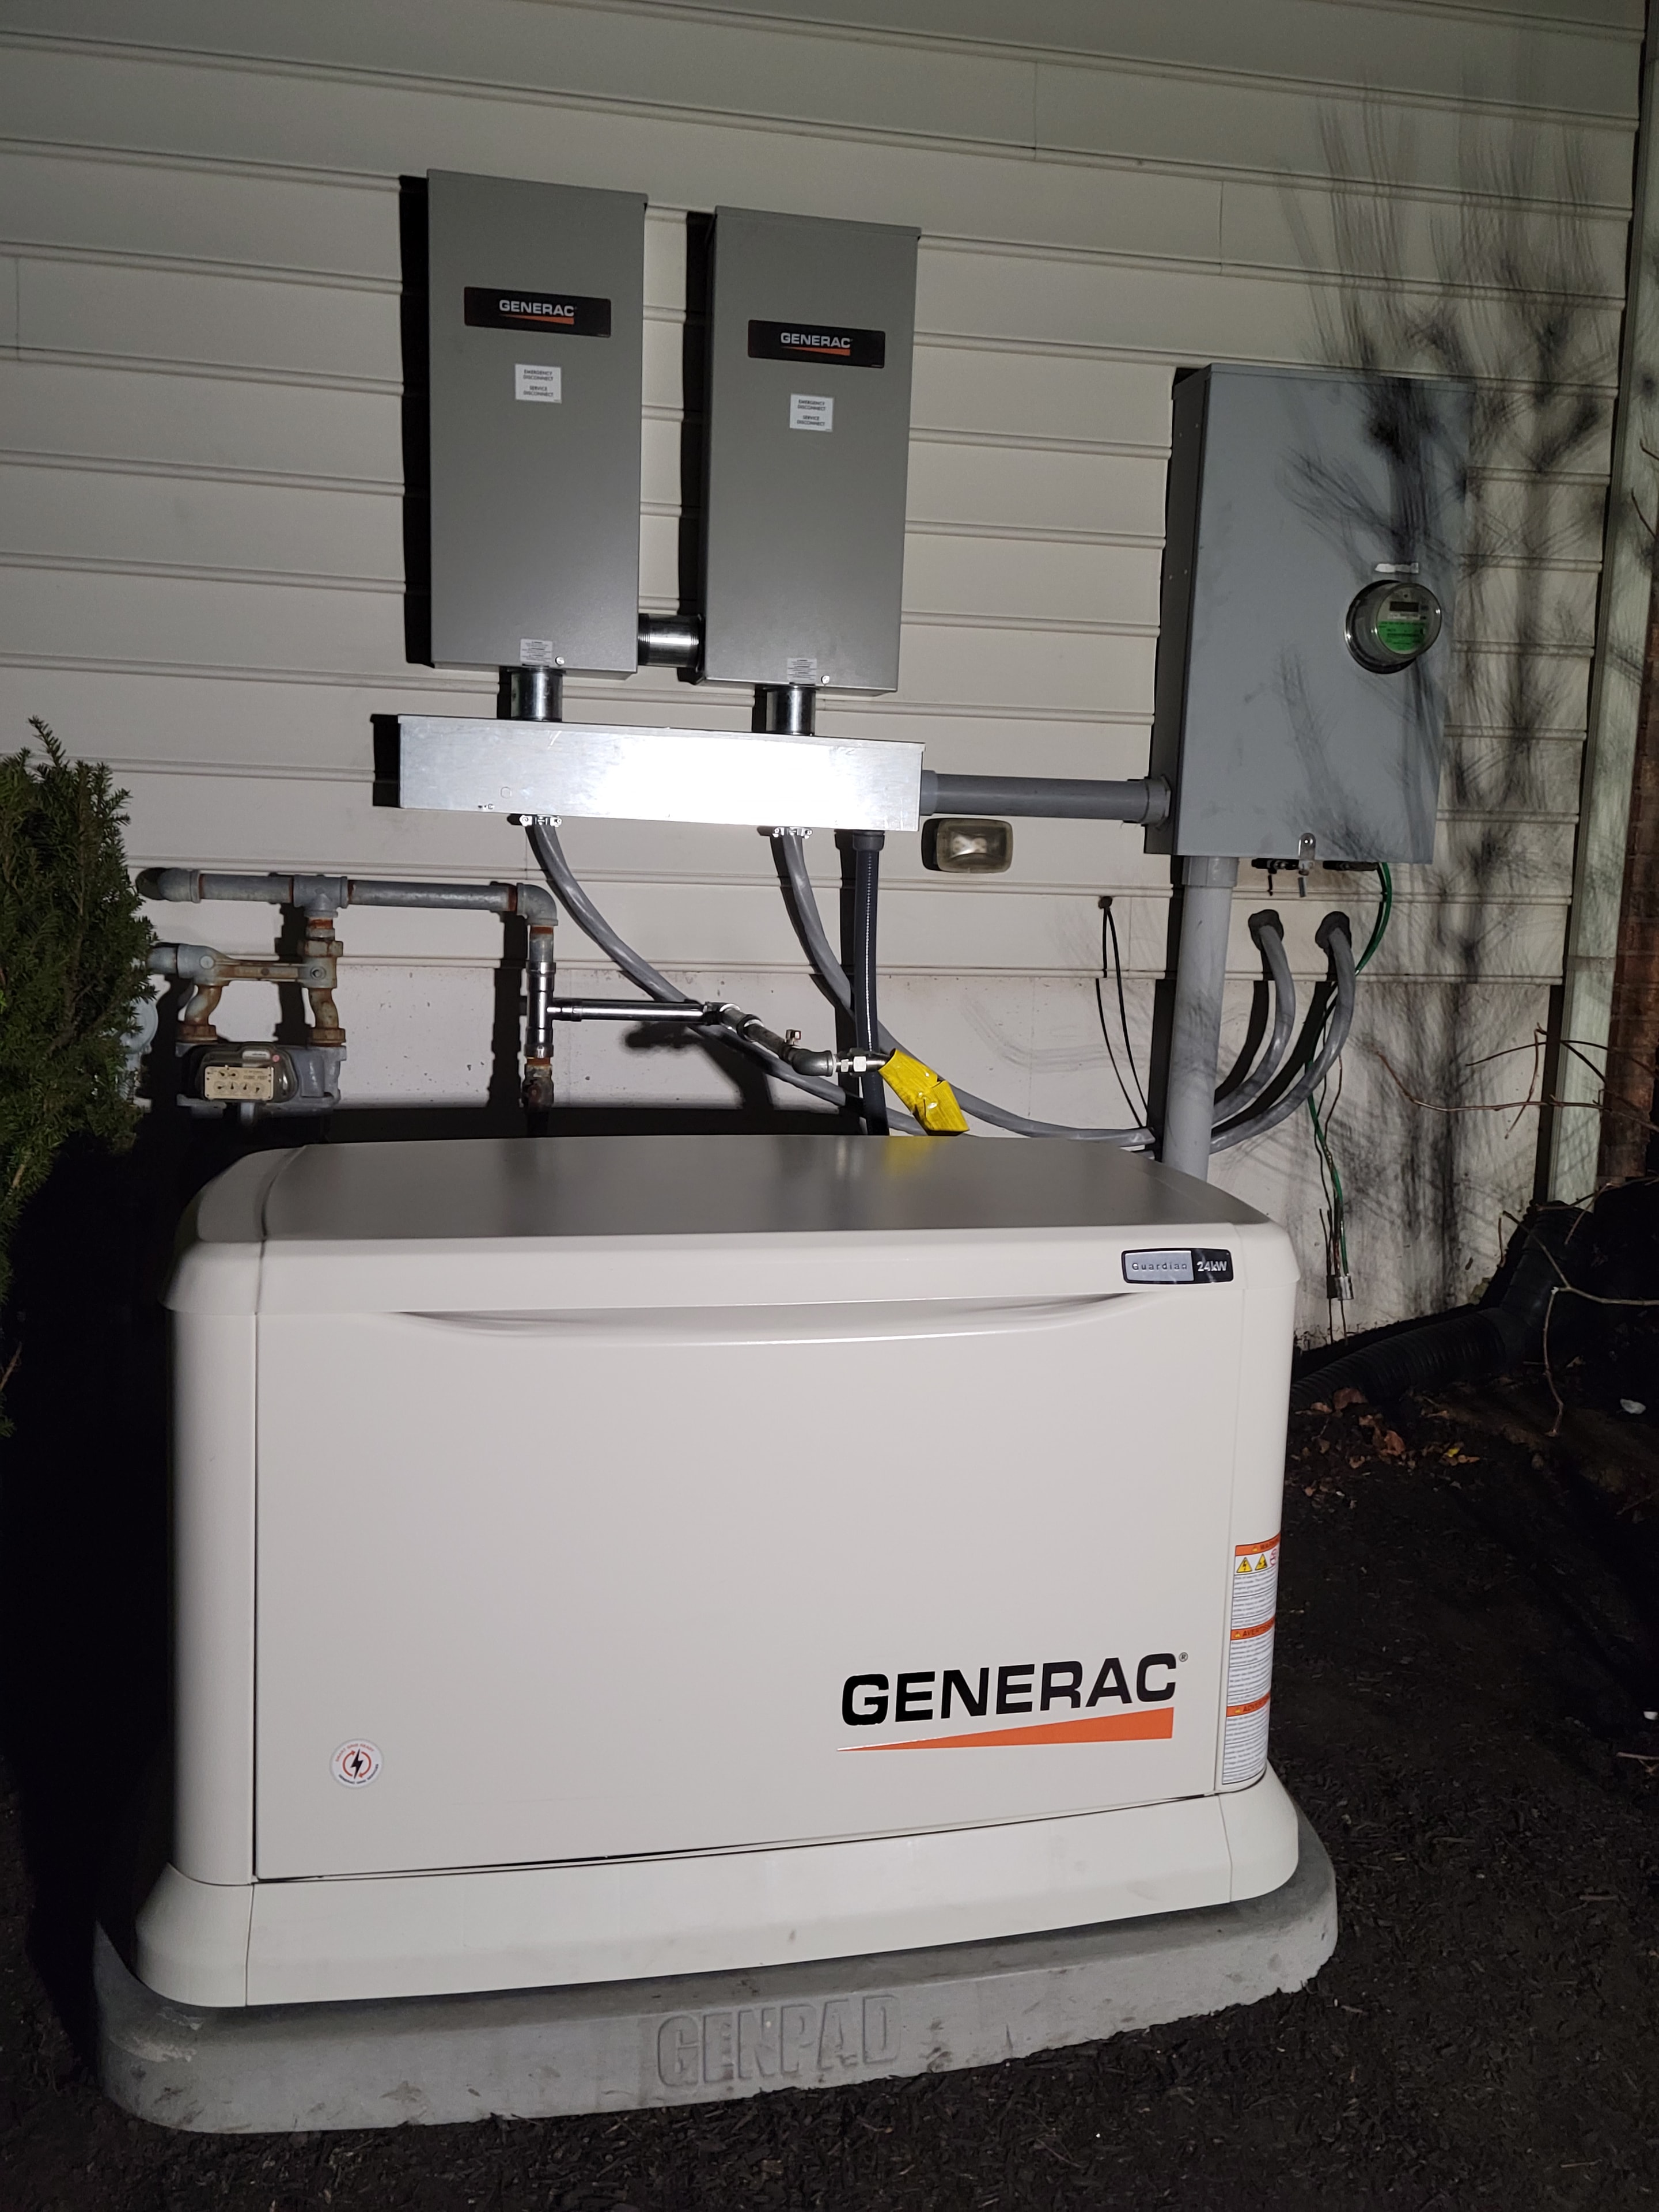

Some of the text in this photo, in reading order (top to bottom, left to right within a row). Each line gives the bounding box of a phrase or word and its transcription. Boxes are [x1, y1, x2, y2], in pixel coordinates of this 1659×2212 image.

[499, 300, 574, 317] GENERAC
[781, 332, 851, 349] GENERAC
[1131, 1260, 1227, 1272] Guardian 24kW
[658, 1994, 902, 2088] GENPAD
